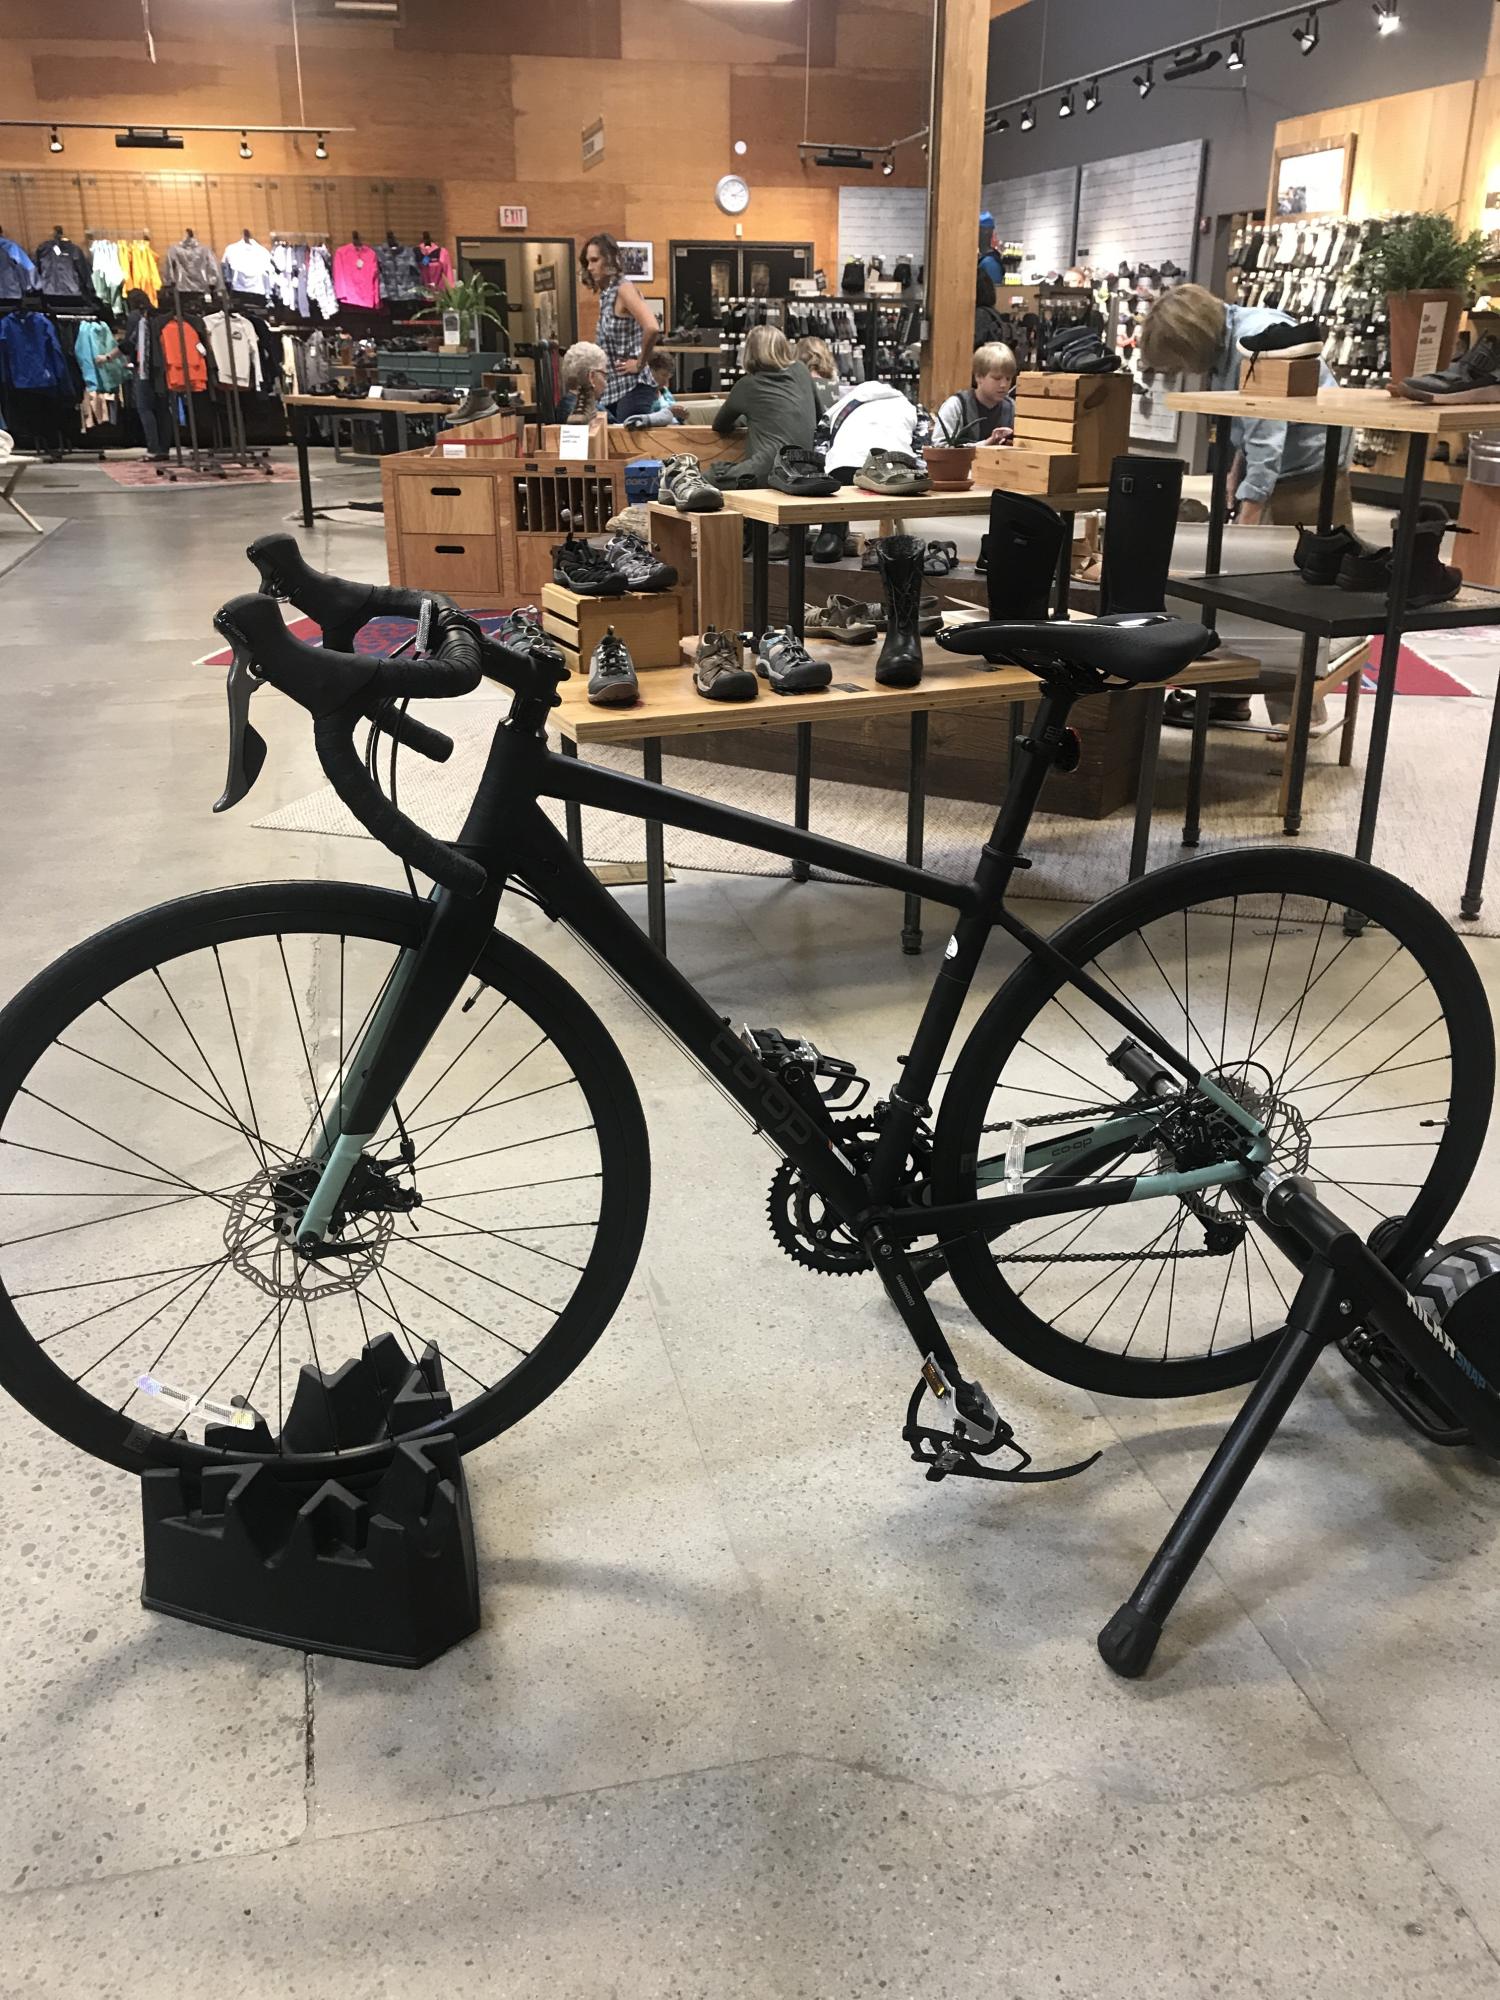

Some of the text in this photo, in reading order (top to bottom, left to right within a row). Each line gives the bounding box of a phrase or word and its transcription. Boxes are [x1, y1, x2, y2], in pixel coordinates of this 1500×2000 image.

[504, 208, 523, 225] EXIT
[896, 1273, 915, 1306] SHIMANO
[1455, 1347, 1486, 1390] SNAP
